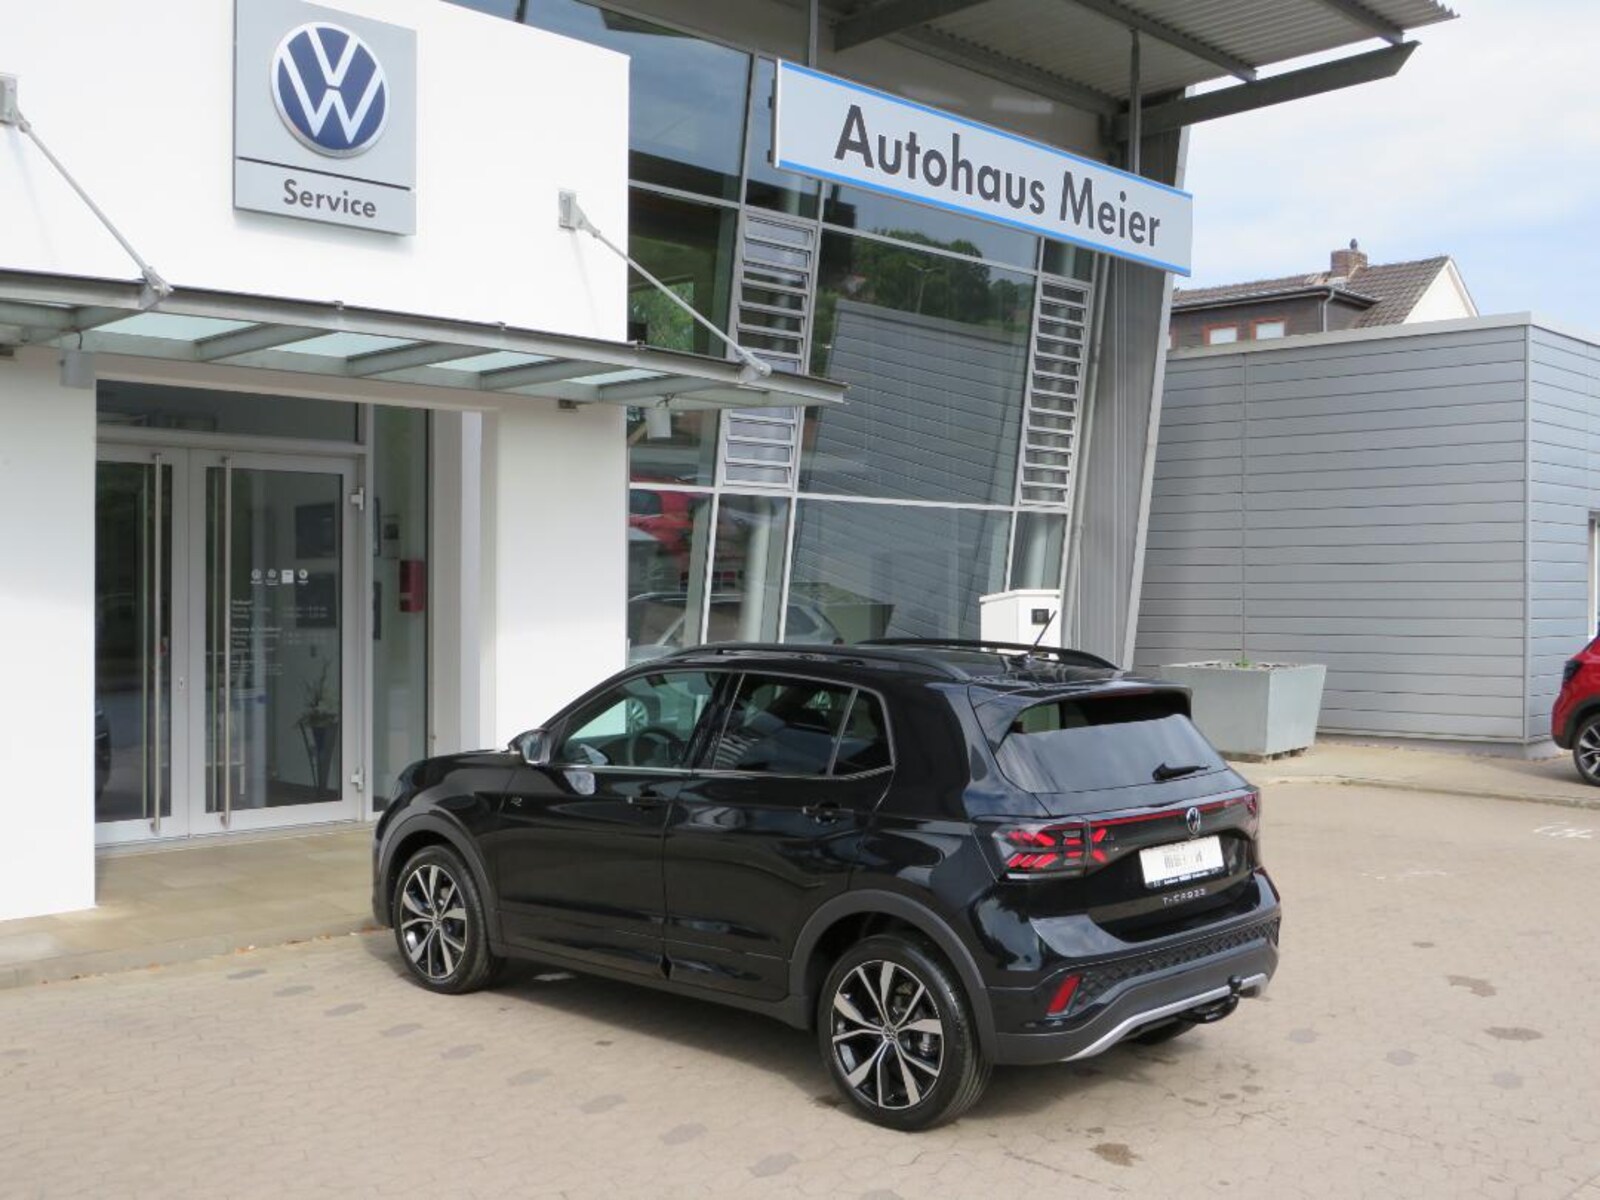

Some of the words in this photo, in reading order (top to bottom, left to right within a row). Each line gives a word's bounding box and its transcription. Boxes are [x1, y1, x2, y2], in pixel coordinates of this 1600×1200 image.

[272, 22, 389, 153] VW
[283, 178, 377, 219] Service
[834, 104, 1045, 216] Autohaus
[1059, 171, 1161, 247] Meier
